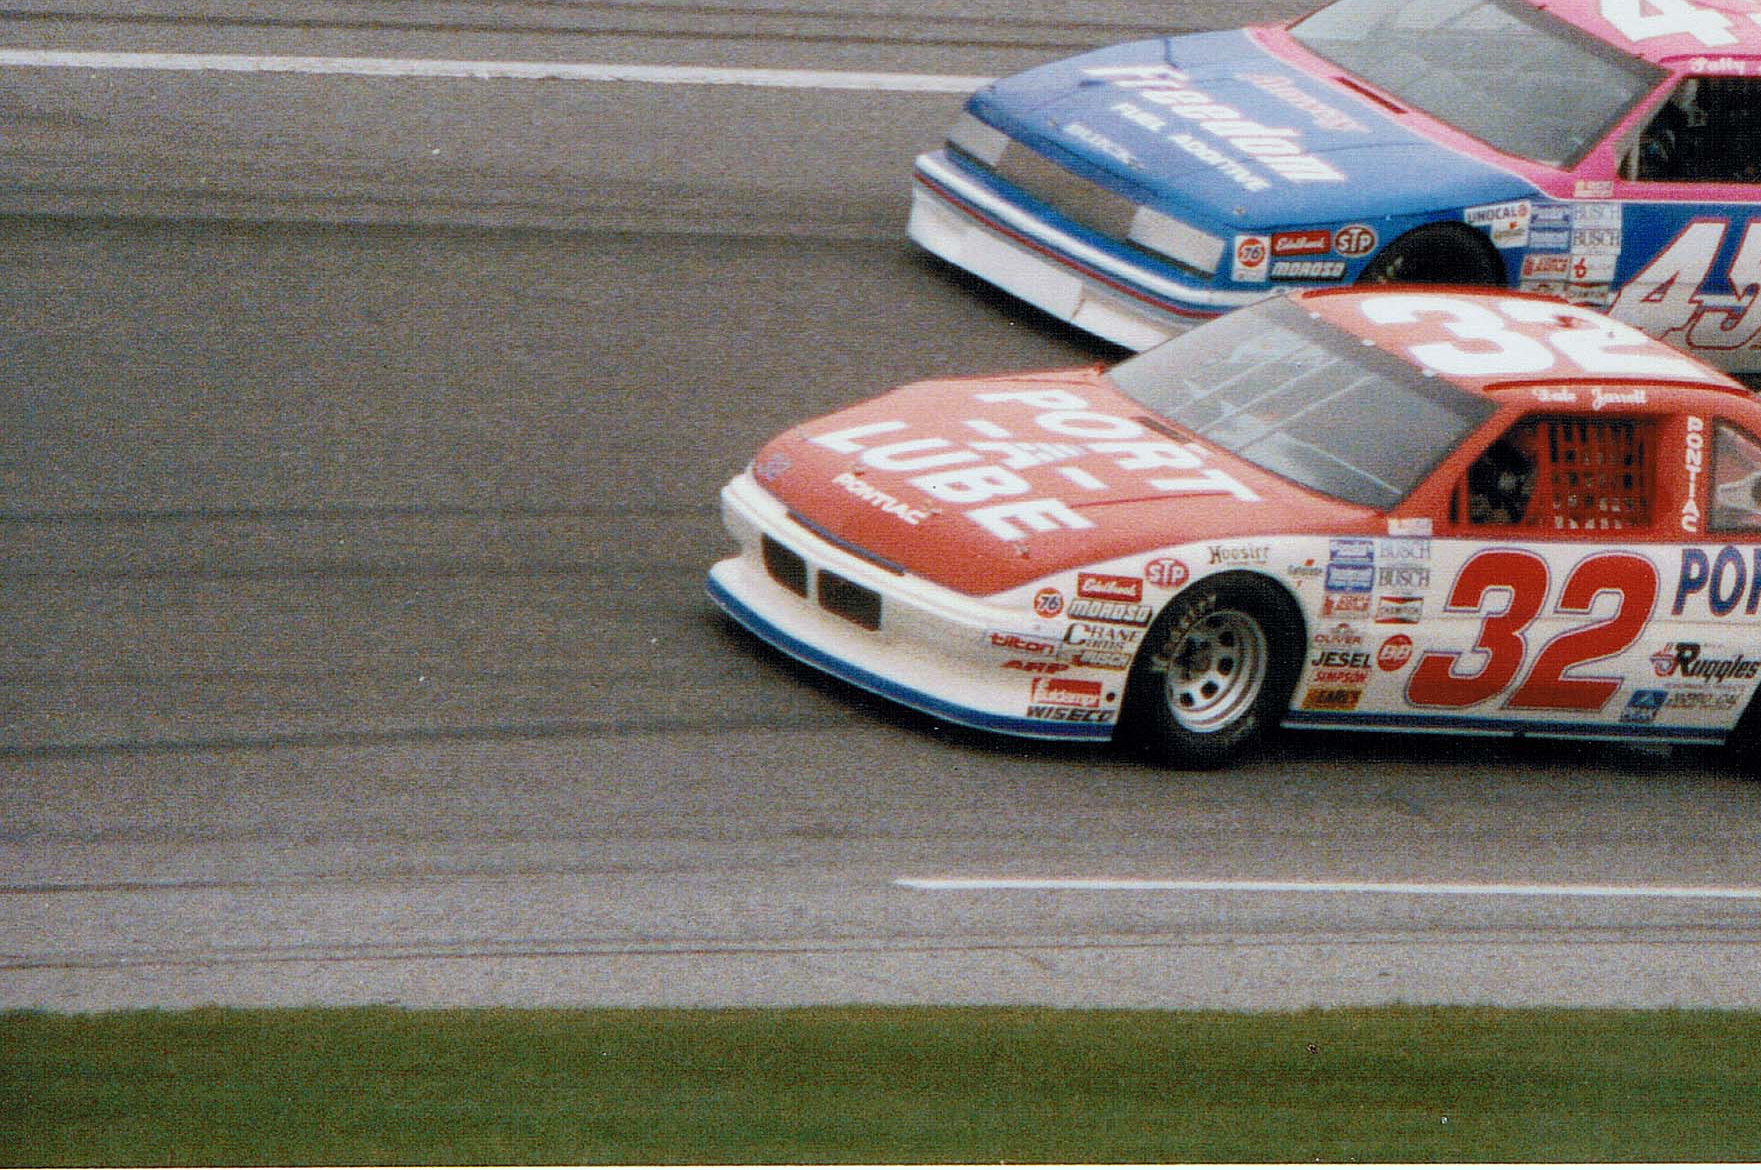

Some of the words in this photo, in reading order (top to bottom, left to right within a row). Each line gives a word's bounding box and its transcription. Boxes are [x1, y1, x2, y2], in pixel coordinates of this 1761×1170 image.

[1241, 246, 1261, 260] 76
[1337, 229, 1373, 255] STP
[1271, 260, 1346, 278] MOROSO
[1361, 295, 1735, 386] 32
[975, 388, 1263, 503] PORT
[808, 420, 1098, 542] LUBE
[832, 472, 928, 526] PONTIAC
[1148, 559, 1186, 584] STP
[1378, 566, 1431, 587] BUSCH
[1038, 595, 1061, 610] 76
[1067, 599, 1153, 628] MOROSO
[1403, 546, 1664, 711] 32
[1311, 651, 1374, 669] JESEL
[1026, 704, 1118, 723] WISECO
